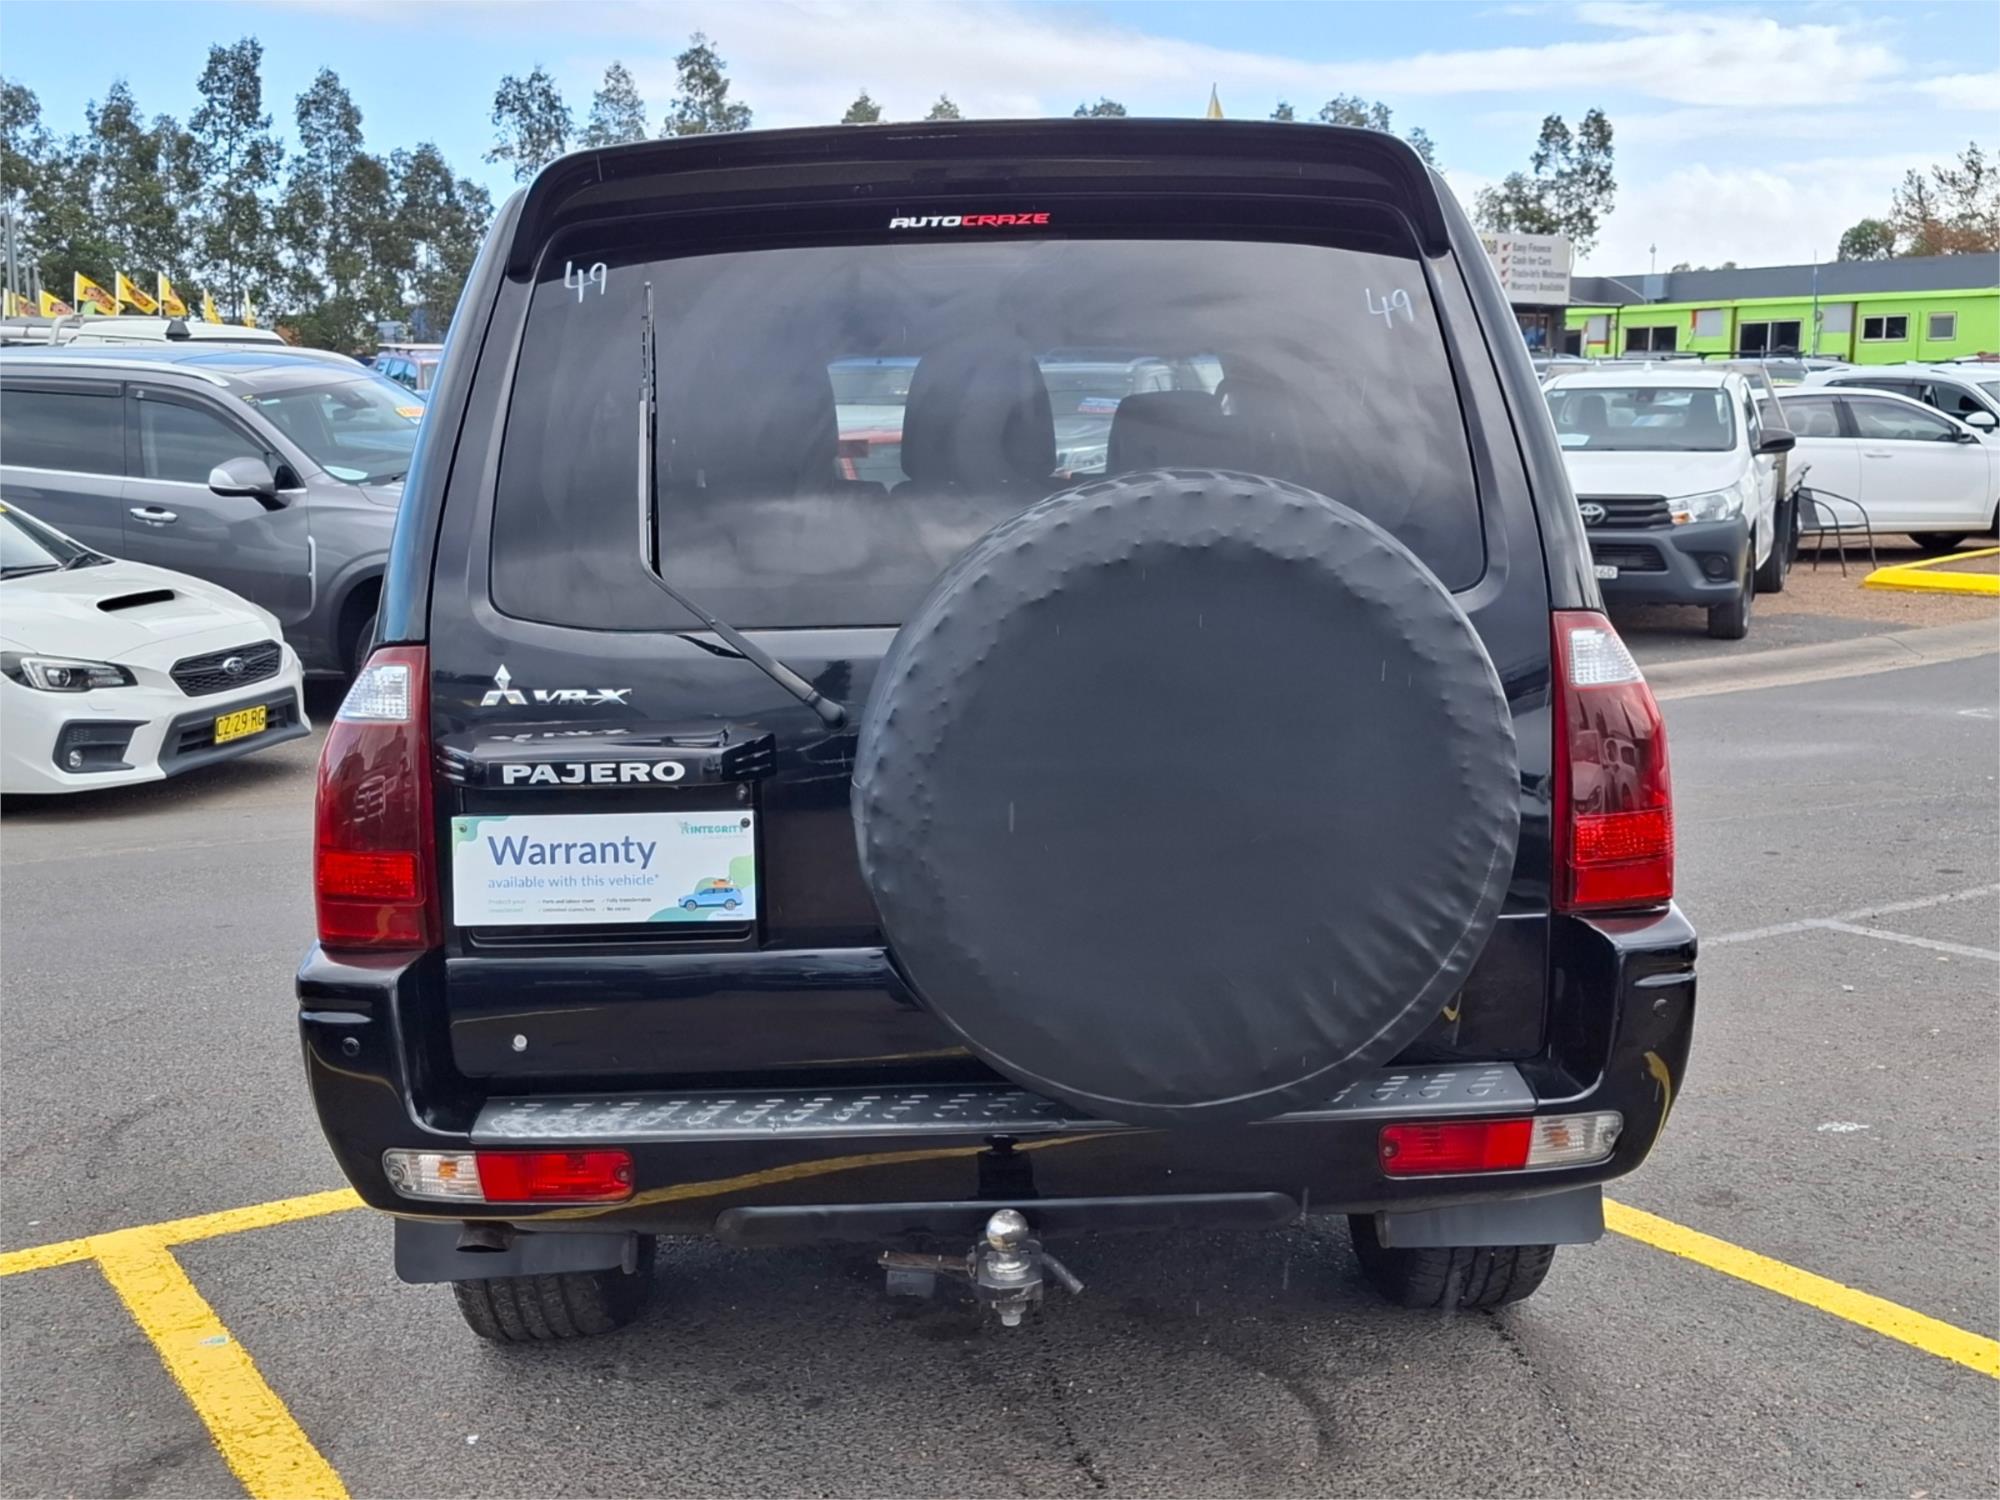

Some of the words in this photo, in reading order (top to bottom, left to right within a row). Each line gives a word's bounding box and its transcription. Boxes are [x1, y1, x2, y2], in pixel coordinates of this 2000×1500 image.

[889, 213, 1051, 229] AUTOCRAZE
[1512, 243, 1526, 254] Easy
[1511, 255, 1527, 265] Cash
[1528, 256, 1536, 265] for
[1538, 256, 1552, 266] Cars
[563, 260, 608, 304] 49
[1511, 281, 1537, 293] Warranty
[1365, 287, 1415, 330] 49
[532, 688, 632, 705] VR-X
[217, 717, 231, 736] CZ
[234, 712, 247, 732] 29
[502, 761, 686, 785] PAJERO
[488, 835, 657, 870] Warranty
[488, 876, 545, 889] available
[548, 875, 577, 888] with
[580, 874, 605, 887] this
